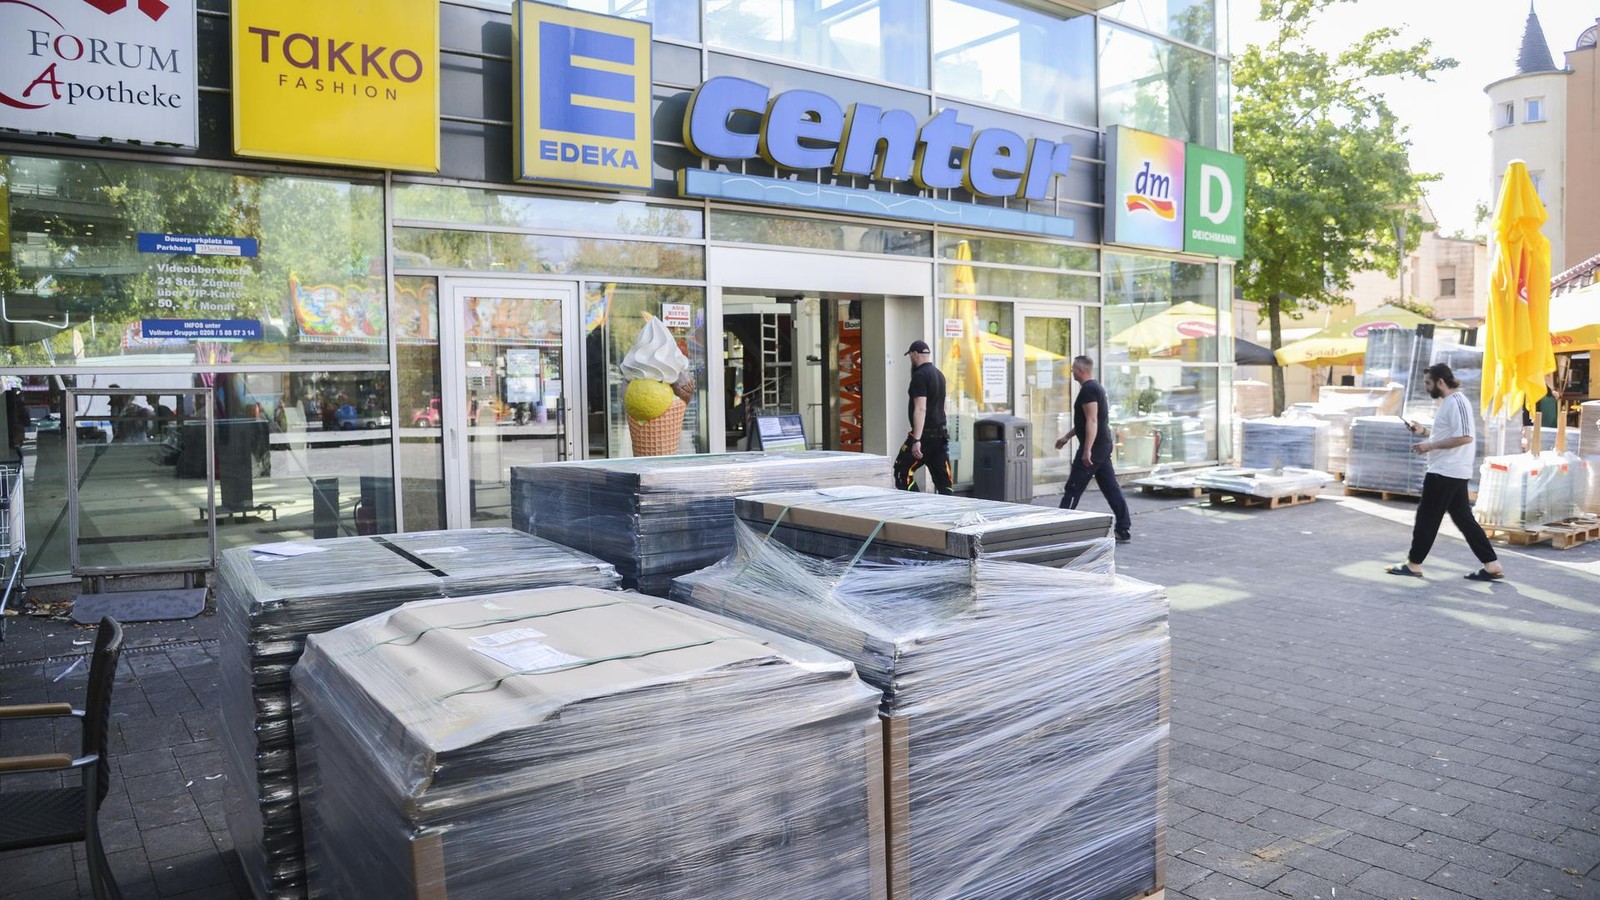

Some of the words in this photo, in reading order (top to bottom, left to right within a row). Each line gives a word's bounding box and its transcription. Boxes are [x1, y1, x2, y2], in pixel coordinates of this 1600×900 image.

[27, 29, 181, 73] FORUM
[22, 62, 182, 109] Apotheke
[279, 74, 397, 101] FASHION
[683, 76, 1072, 200] center
[540, 140, 639, 170] EDEKA
[1135, 162, 1170, 199] dm
[1200, 164, 1232, 225] D
[156, 244, 193, 252] Parkhaus
[164, 235, 222, 246] Dauerparkplatz
[1192, 229, 1237, 245] DEICHMANN
[157, 277, 173, 286] 24
[175, 277, 198, 286] Std.
[201, 278, 244, 289] Zugang
[157, 287, 184, 297] über
[187, 289, 241, 299] VIP-Karte
[157, 299, 179, 311] 50,-
[200, 301, 235, 311] Monat
